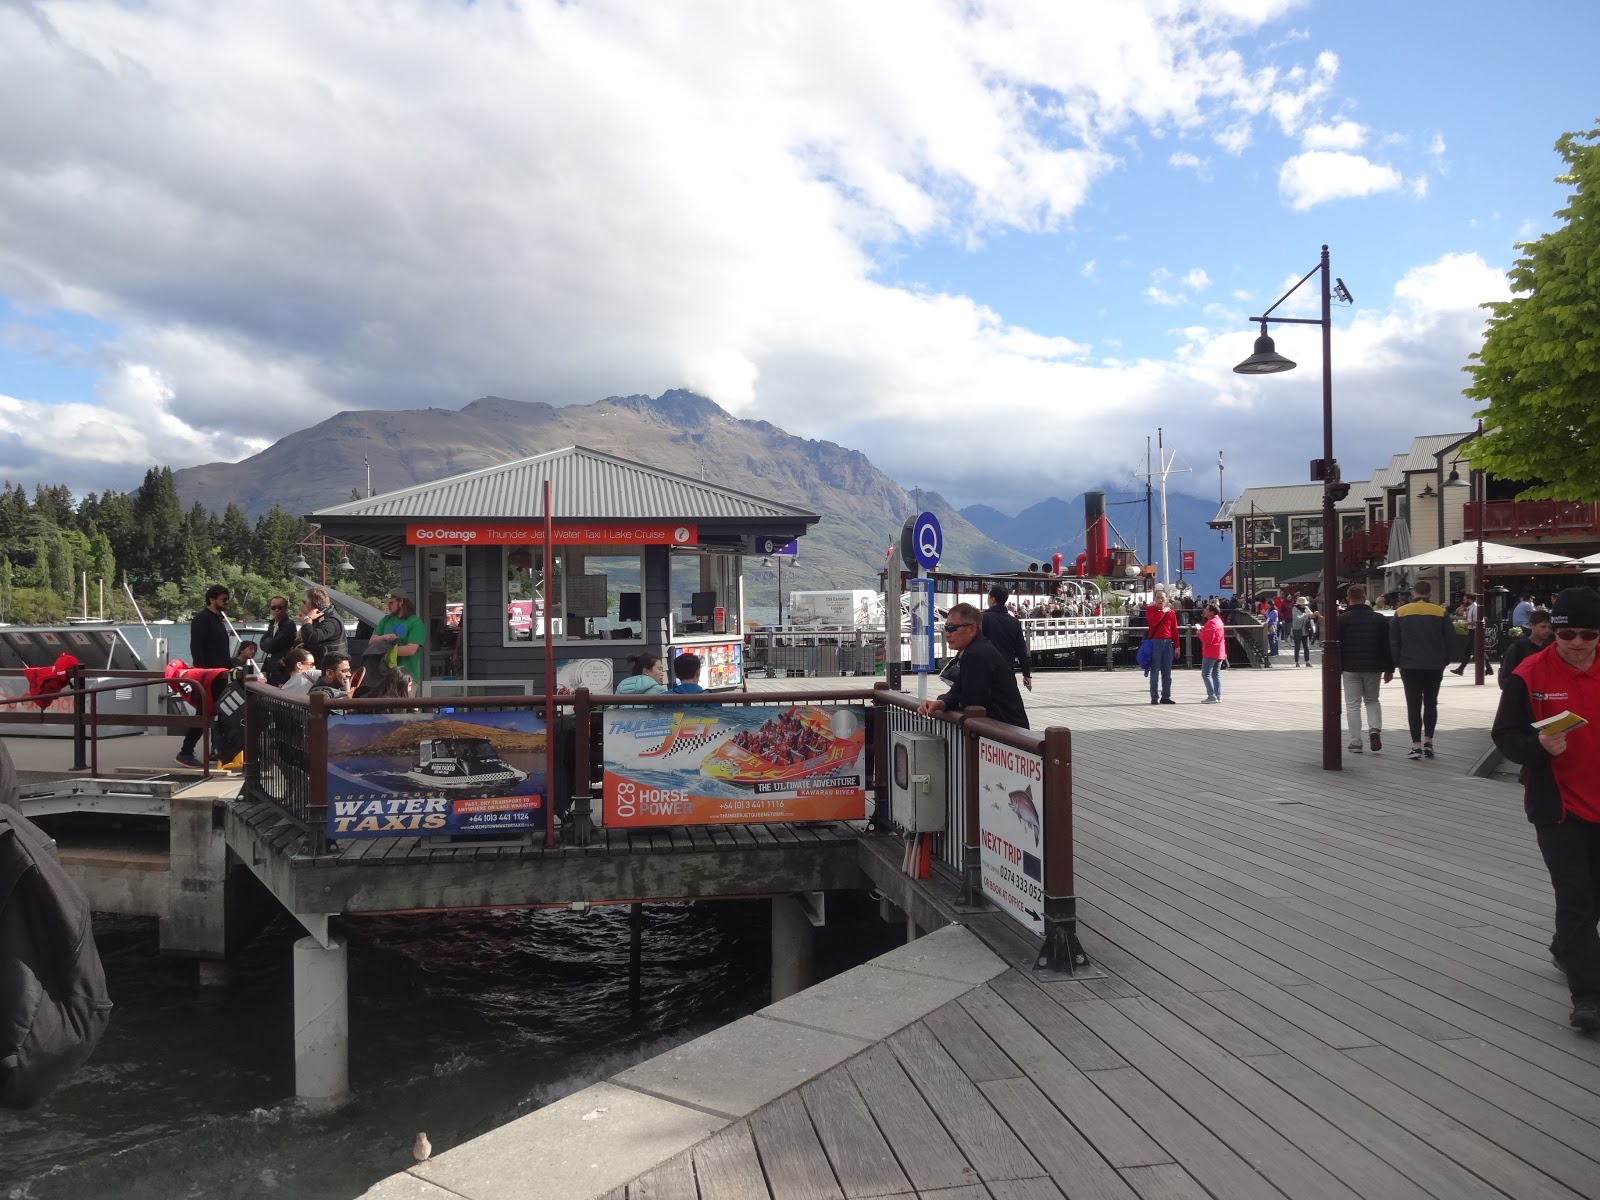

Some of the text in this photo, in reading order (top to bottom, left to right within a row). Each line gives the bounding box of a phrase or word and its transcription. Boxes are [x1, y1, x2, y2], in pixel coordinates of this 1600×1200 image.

[416, 528, 477, 541] Go Orange
[486, 529, 528, 539] Thunder
[530, 529, 546, 539] Jet
[554, 529, 581, 539] Water
[584, 529, 601, 539] Taxi
[609, 529, 633, 539] Lake
[634, 529, 666, 539] Cruise
[919, 523, 940, 558] Q
[608, 716, 678, 735] THUNDER
[637, 712, 719, 758] JET
[980, 742, 1041, 782] FISHING TRIPS
[758, 777, 857, 792] THE ULTIMATE ADVENTURE
[836, 788, 855, 796] RIVER
[334, 791, 446, 800] QUEENSTOWN
[617, 782, 636, 817] 820
[639, 789, 690, 803] HORSE
[334, 798, 447, 816] WATER
[457, 805, 487, 813] ANYWHERE
[639, 801, 694, 816] POWER
[734, 801, 744, 809] (0)
[745, 801, 751, 809] 3
[751, 800, 765, 808] 441
[767, 800, 785, 808] 1116
[334, 813, 447, 833] TAXIS
[483, 814, 498, 822] (0)3
[498, 813, 511, 821] 441
[513, 812, 529, 820] 1124
[982, 828, 1022, 866] NEXT TRIP
[1000, 865, 1015, 885] 0274
[1015, 874, 1028, 894] 333
[1028, 883, 1042, 903] 052
[983, 876, 1024, 912] OR BOOK AT OFFICE
